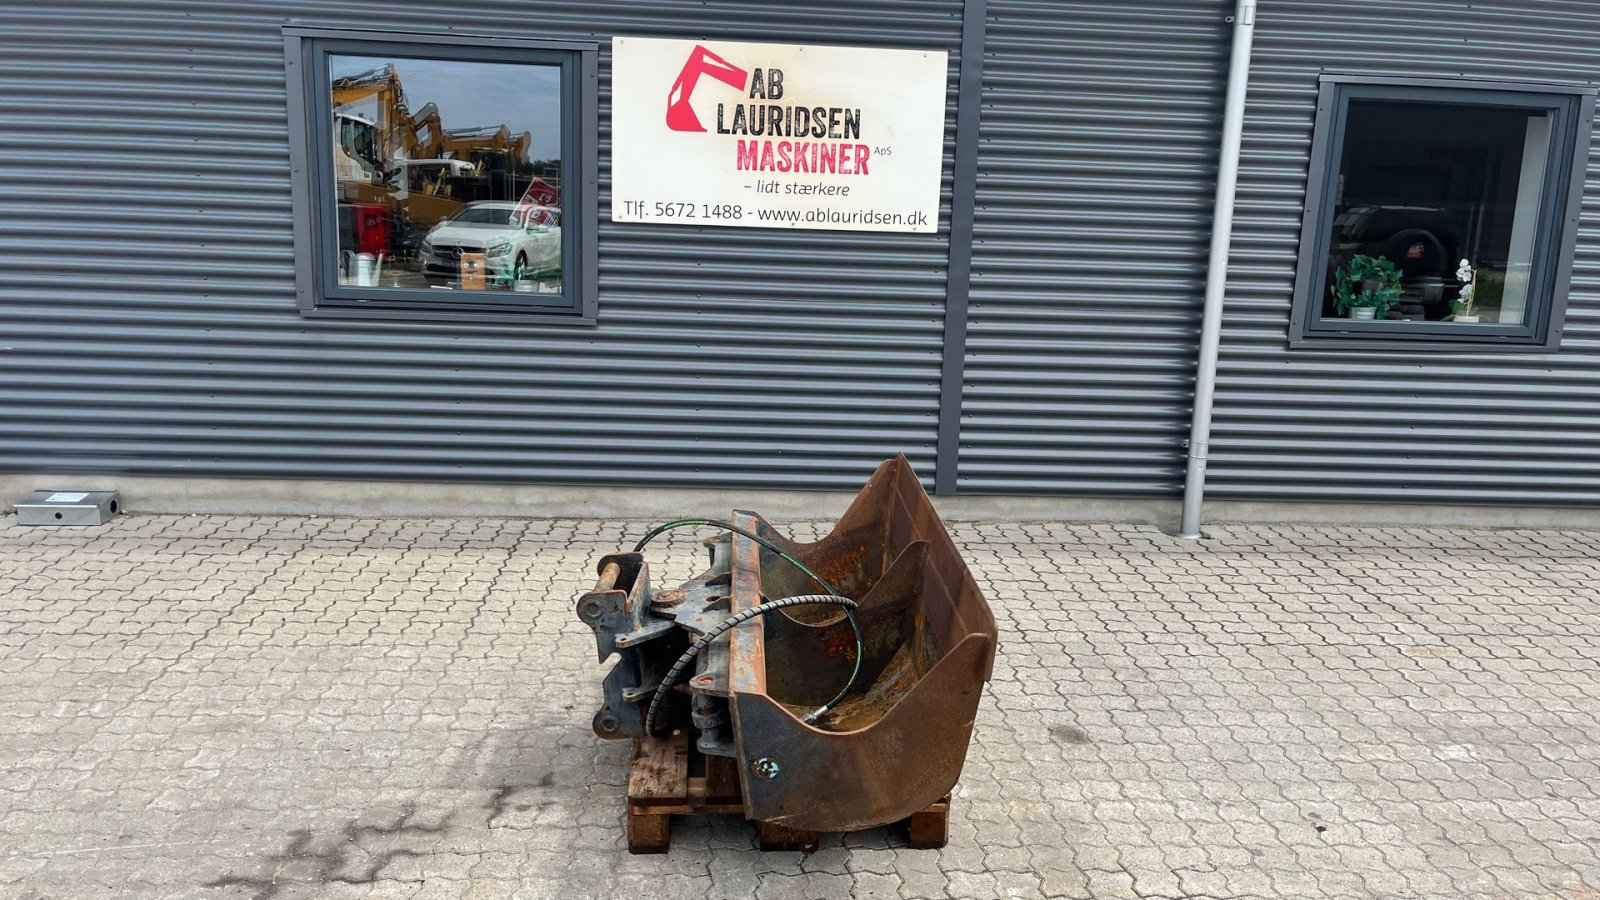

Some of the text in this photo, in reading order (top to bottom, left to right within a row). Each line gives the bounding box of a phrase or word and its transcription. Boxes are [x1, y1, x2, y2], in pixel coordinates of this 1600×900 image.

[749, 67, 784, 100] AB
[716, 103, 861, 139] LAURIDSEN
[736, 140, 892, 175] MASKINER ApS
[756, 180, 780, 195] lidt
[785, 182, 850, 197] stærkere
[623, 200, 649, 219] Tlf.
[655, 202, 696, 218] 5672
[702, 203, 743, 219] 1488
[757, 207, 928, 226] www.ablauridsen.dk
